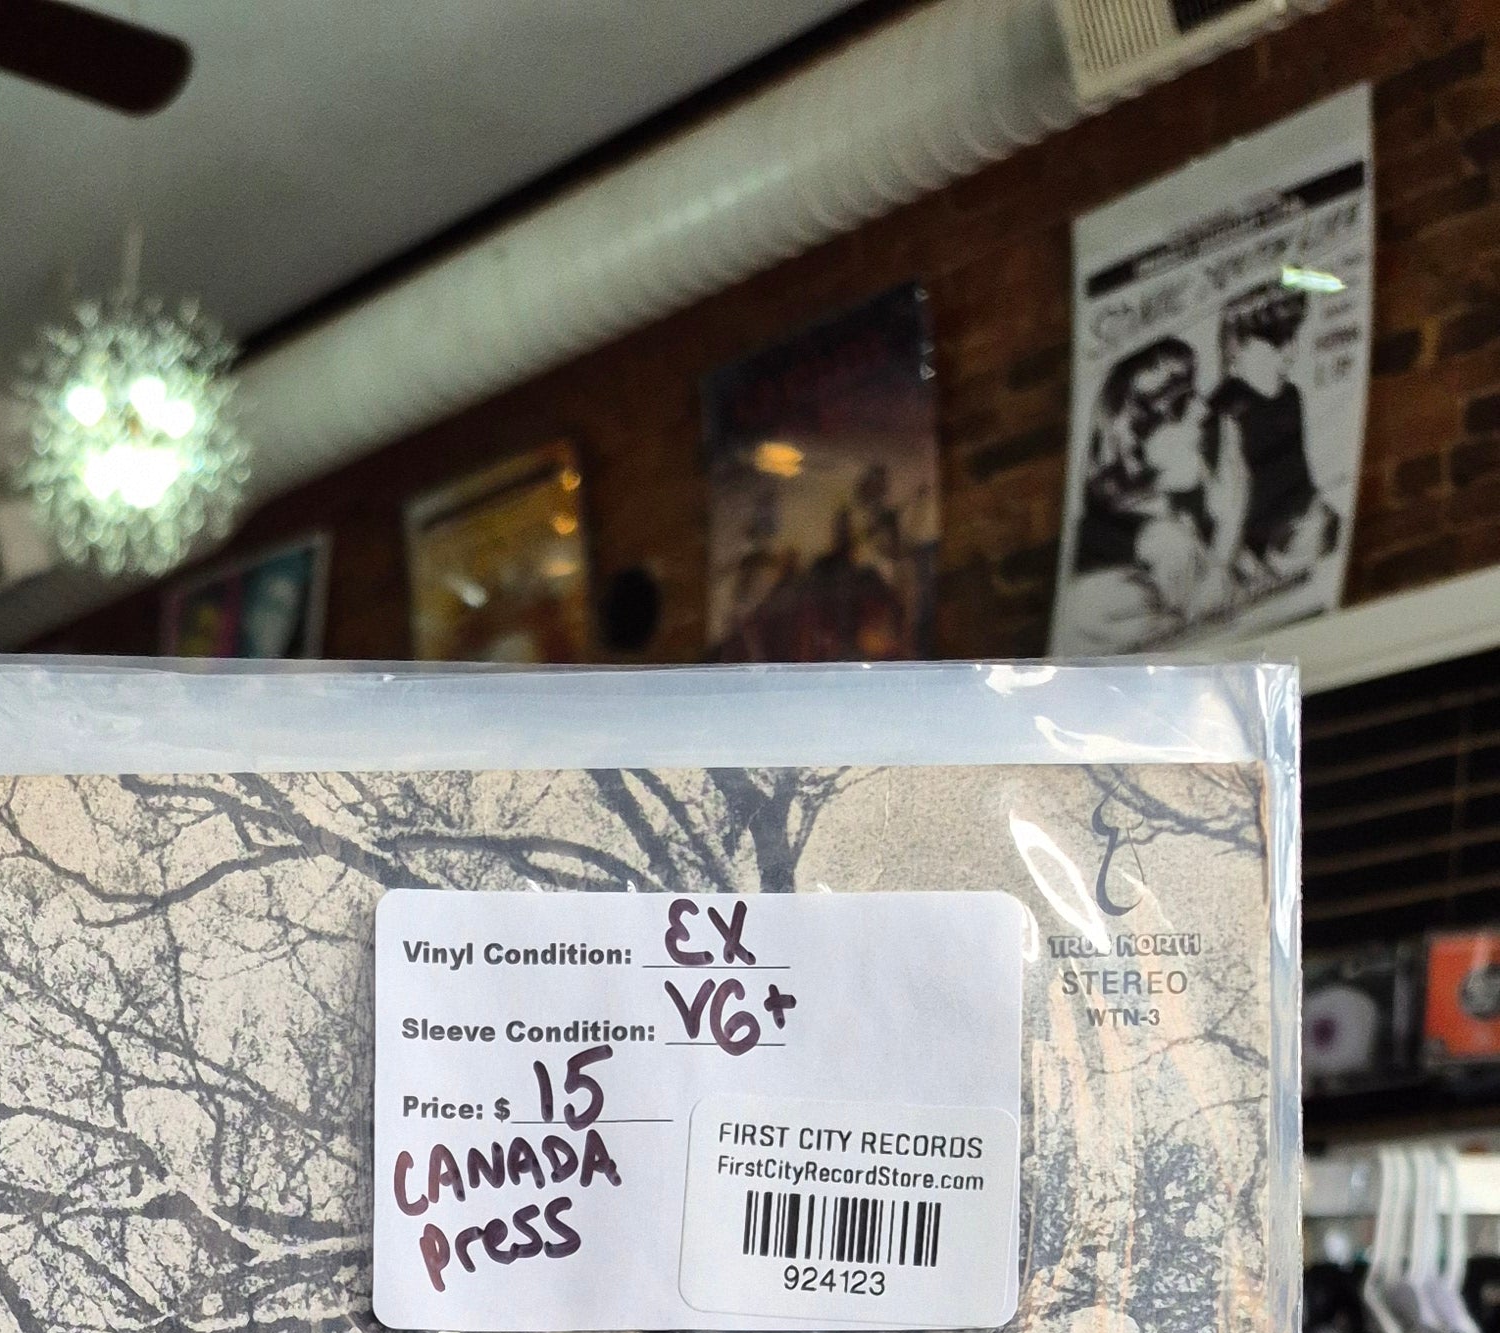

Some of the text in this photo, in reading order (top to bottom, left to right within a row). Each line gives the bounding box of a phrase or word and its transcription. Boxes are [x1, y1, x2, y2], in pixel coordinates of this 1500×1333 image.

[403, 898, 756, 967] Vinyl Condition: EX
[1117, 933, 1201, 957] NORTH
[1061, 970, 1188, 995] STEREO
[401, 1020, 496, 1041] Sleeve
[505, 1021, 655, 1044] Condition:
[1087, 1008, 1161, 1027] WTN-3
[402, 1098, 484, 1121] Price:
[533, 1044, 614, 1131] 15
[718, 1122, 984, 1160] FIRST CITY RECORDS
[393, 1129, 622, 1216] CANADA
[717, 1155, 985, 1192] FirstCityRecordStore.com
[782, 1265, 886, 1297] 924123
